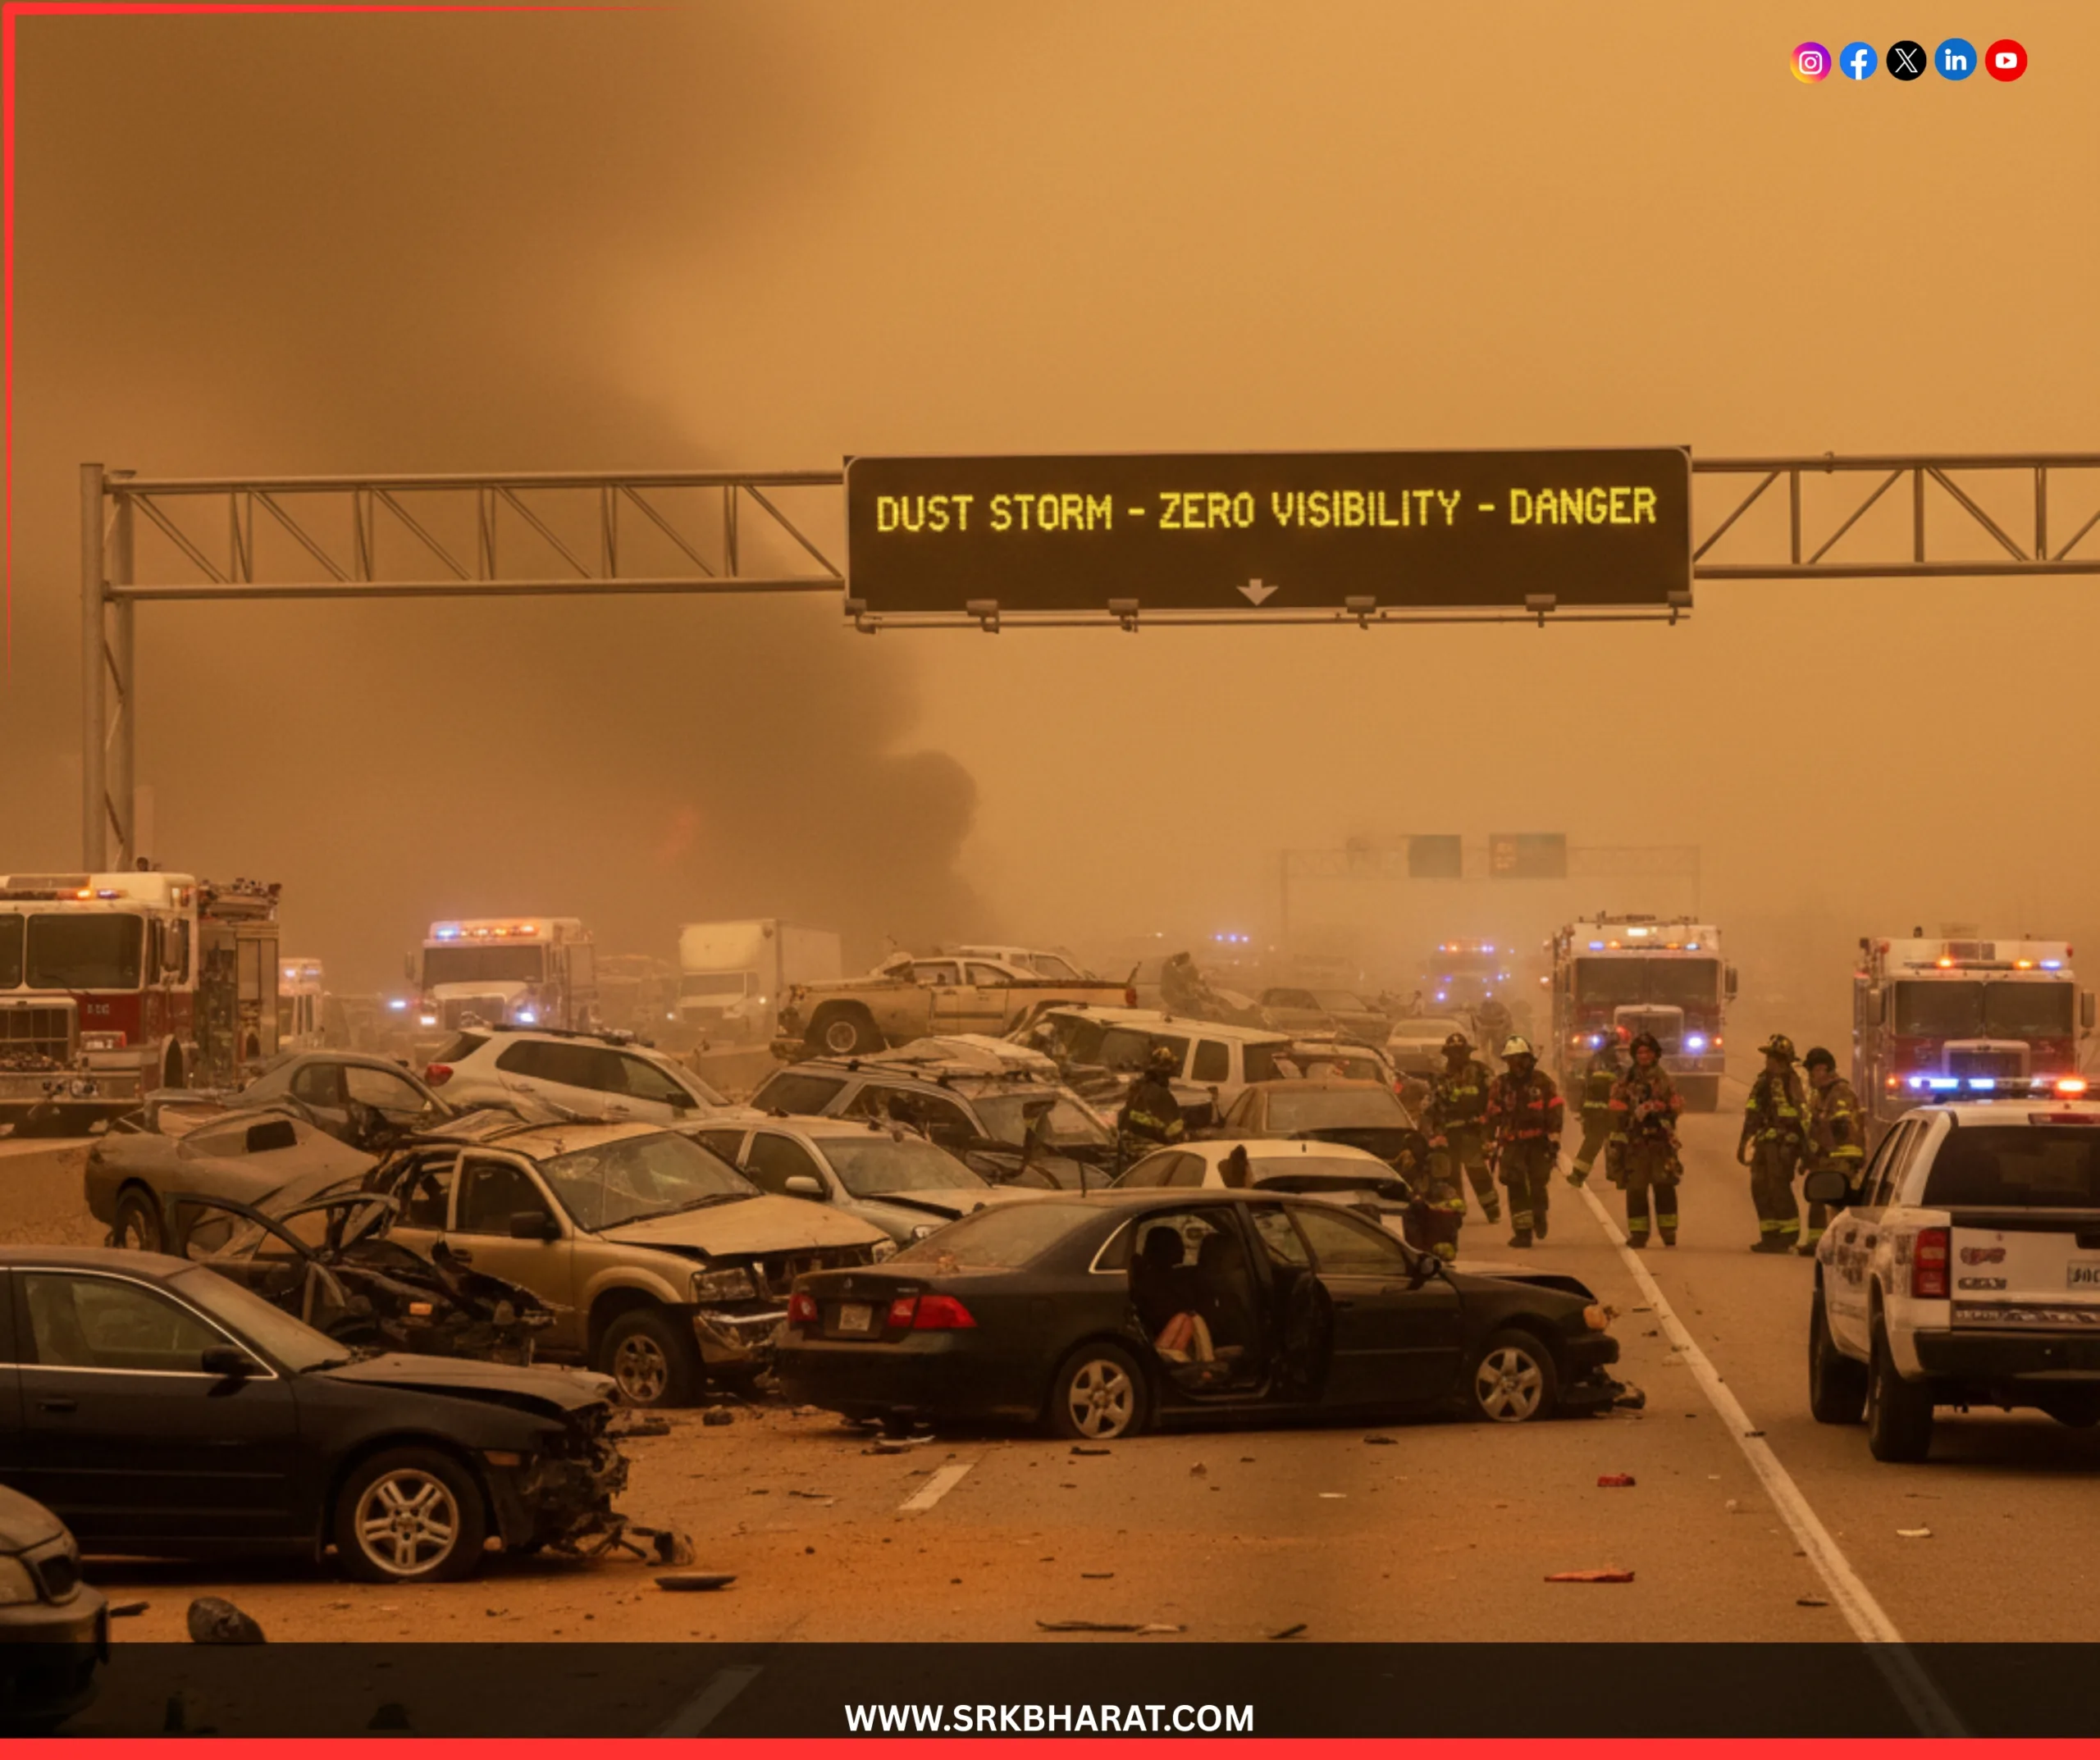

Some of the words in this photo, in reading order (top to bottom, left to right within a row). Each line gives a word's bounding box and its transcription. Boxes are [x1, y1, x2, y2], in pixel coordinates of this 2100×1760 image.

[876, 495, 974, 532] DUST
[989, 494, 1113, 531] STORM
[1158, 491, 1255, 530] ZERO
[1271, 490, 1462, 528] VISIBILITY
[1509, 486, 1657, 525] DANGER
